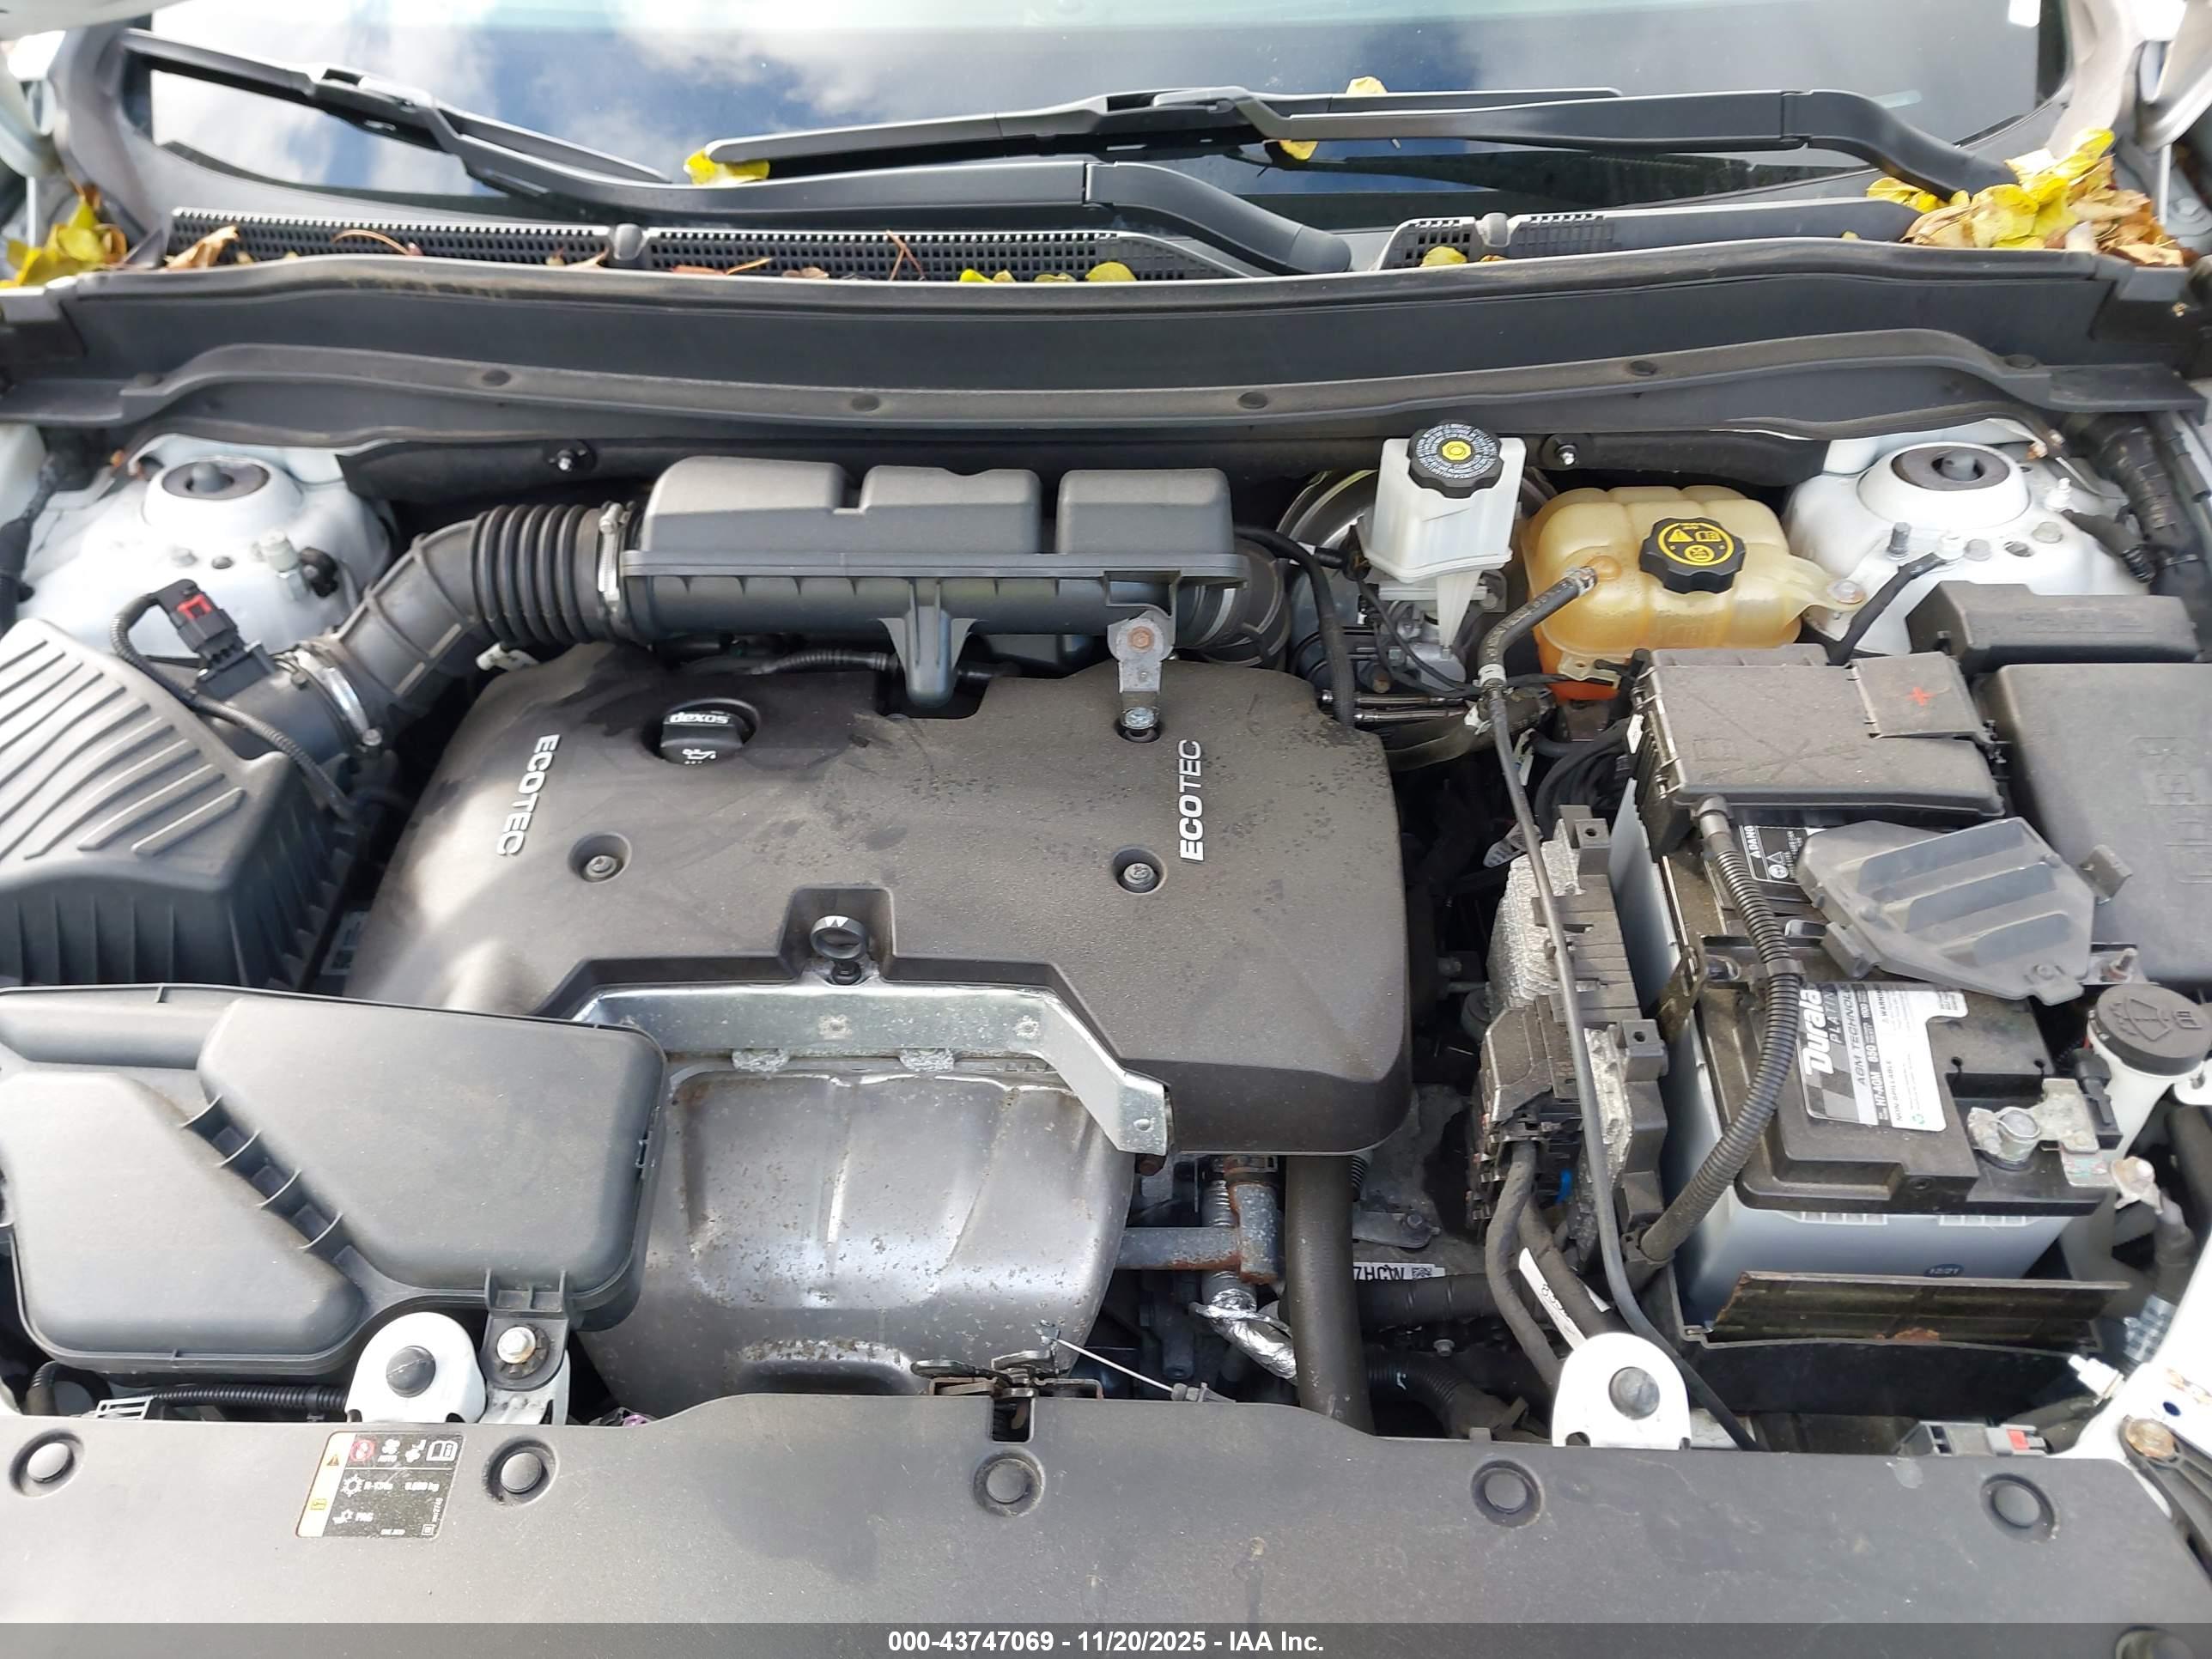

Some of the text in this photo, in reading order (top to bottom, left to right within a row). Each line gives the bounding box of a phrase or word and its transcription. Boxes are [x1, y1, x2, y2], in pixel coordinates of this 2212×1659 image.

[670, 712, 730, 724] dexos
[497, 734, 561, 855] ECOTEC
[1178, 739, 1204, 861] ECOTEC
[1799, 988, 1834, 1075] Durala
[1822, 987, 1844, 1045] PLATIN
